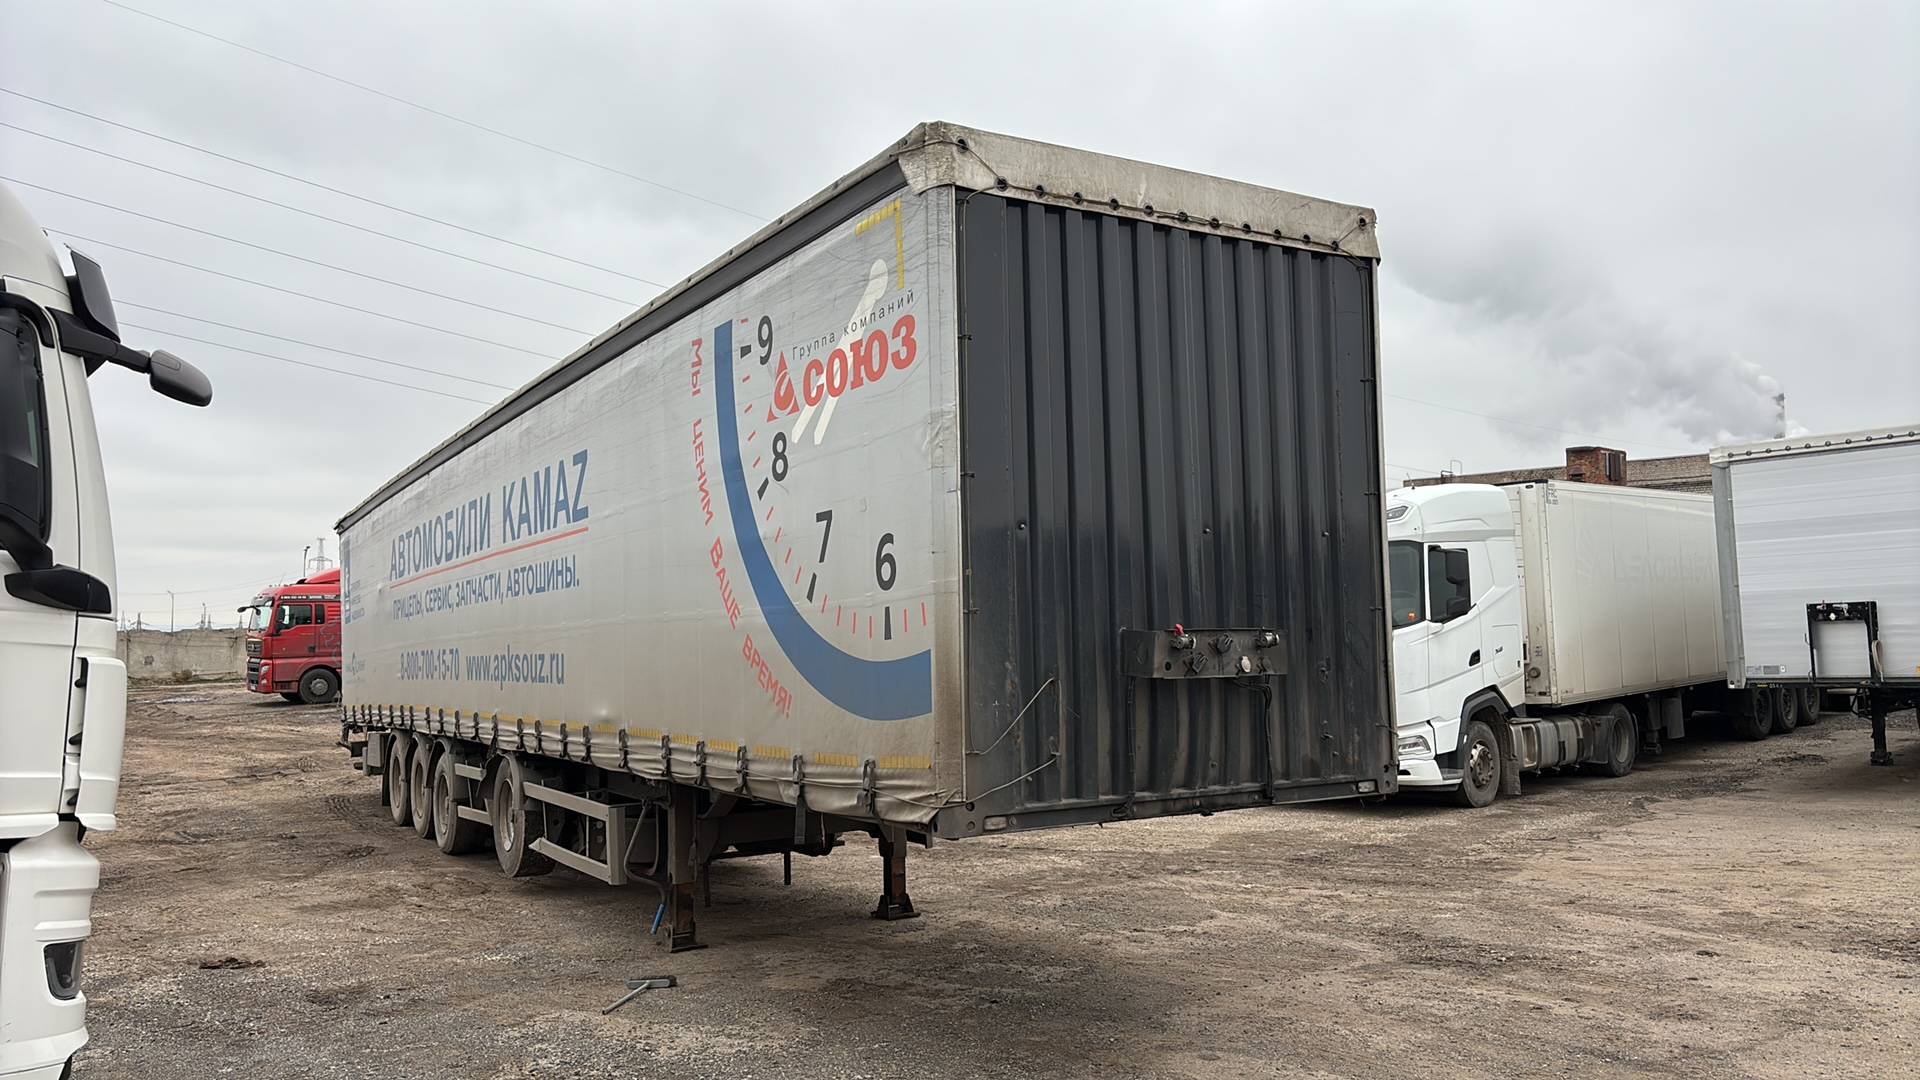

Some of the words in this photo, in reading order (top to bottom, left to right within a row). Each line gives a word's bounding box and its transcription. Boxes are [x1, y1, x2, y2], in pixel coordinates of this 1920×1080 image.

[757, 315, 774, 366] 9
[792, 332, 836, 361] Группа
[843, 289, 915, 336] компаний
[691, 338, 703, 396] МЫ
[802, 314, 918, 408] СОЮЗ
[692, 418, 714, 526] ЦЕНИМ
[771, 431, 789, 482] 8
[389, 492, 491, 580] АВТОМОБИЛИ
[502, 449, 589, 544] KAMAZ
[815, 509, 833, 563] 7
[455, 571, 504, 608] ЗАПЧАСТИ,
[506, 555, 580, 598] АВТОШИНЫ.
[709, 536, 742, 630] ВАШЕ
[875, 532, 897, 591] 6
[400, 648, 460, 681] 8-800-700-15-70
[466, 645, 565, 691] www.apksouz.ru
[741, 633, 793, 719] ВРЕМЯ!
